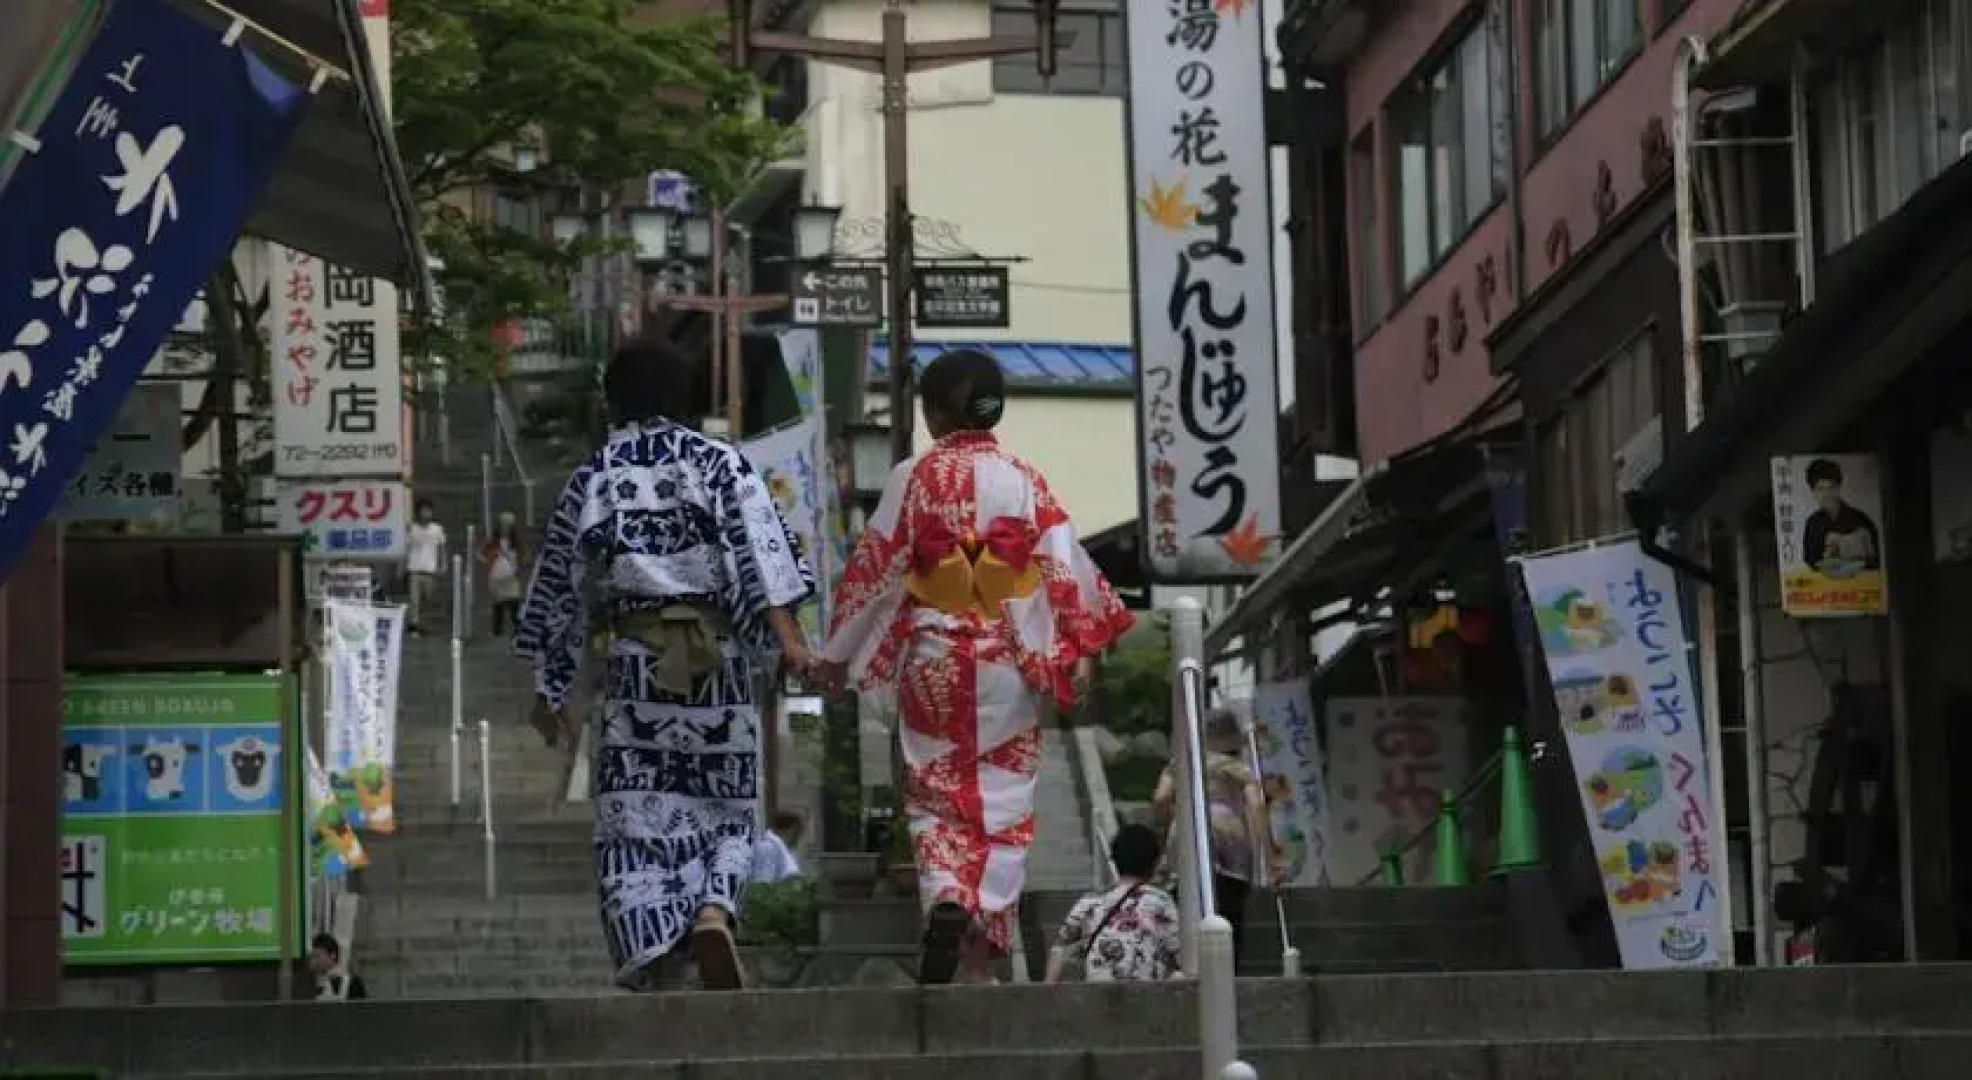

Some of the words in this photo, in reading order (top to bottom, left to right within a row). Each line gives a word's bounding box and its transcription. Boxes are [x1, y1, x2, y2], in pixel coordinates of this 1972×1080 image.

[825, 295, 872, 311] トイレ
[295, 488, 391, 522] クスリ
[120, 905, 274, 937] グリーン牧場
